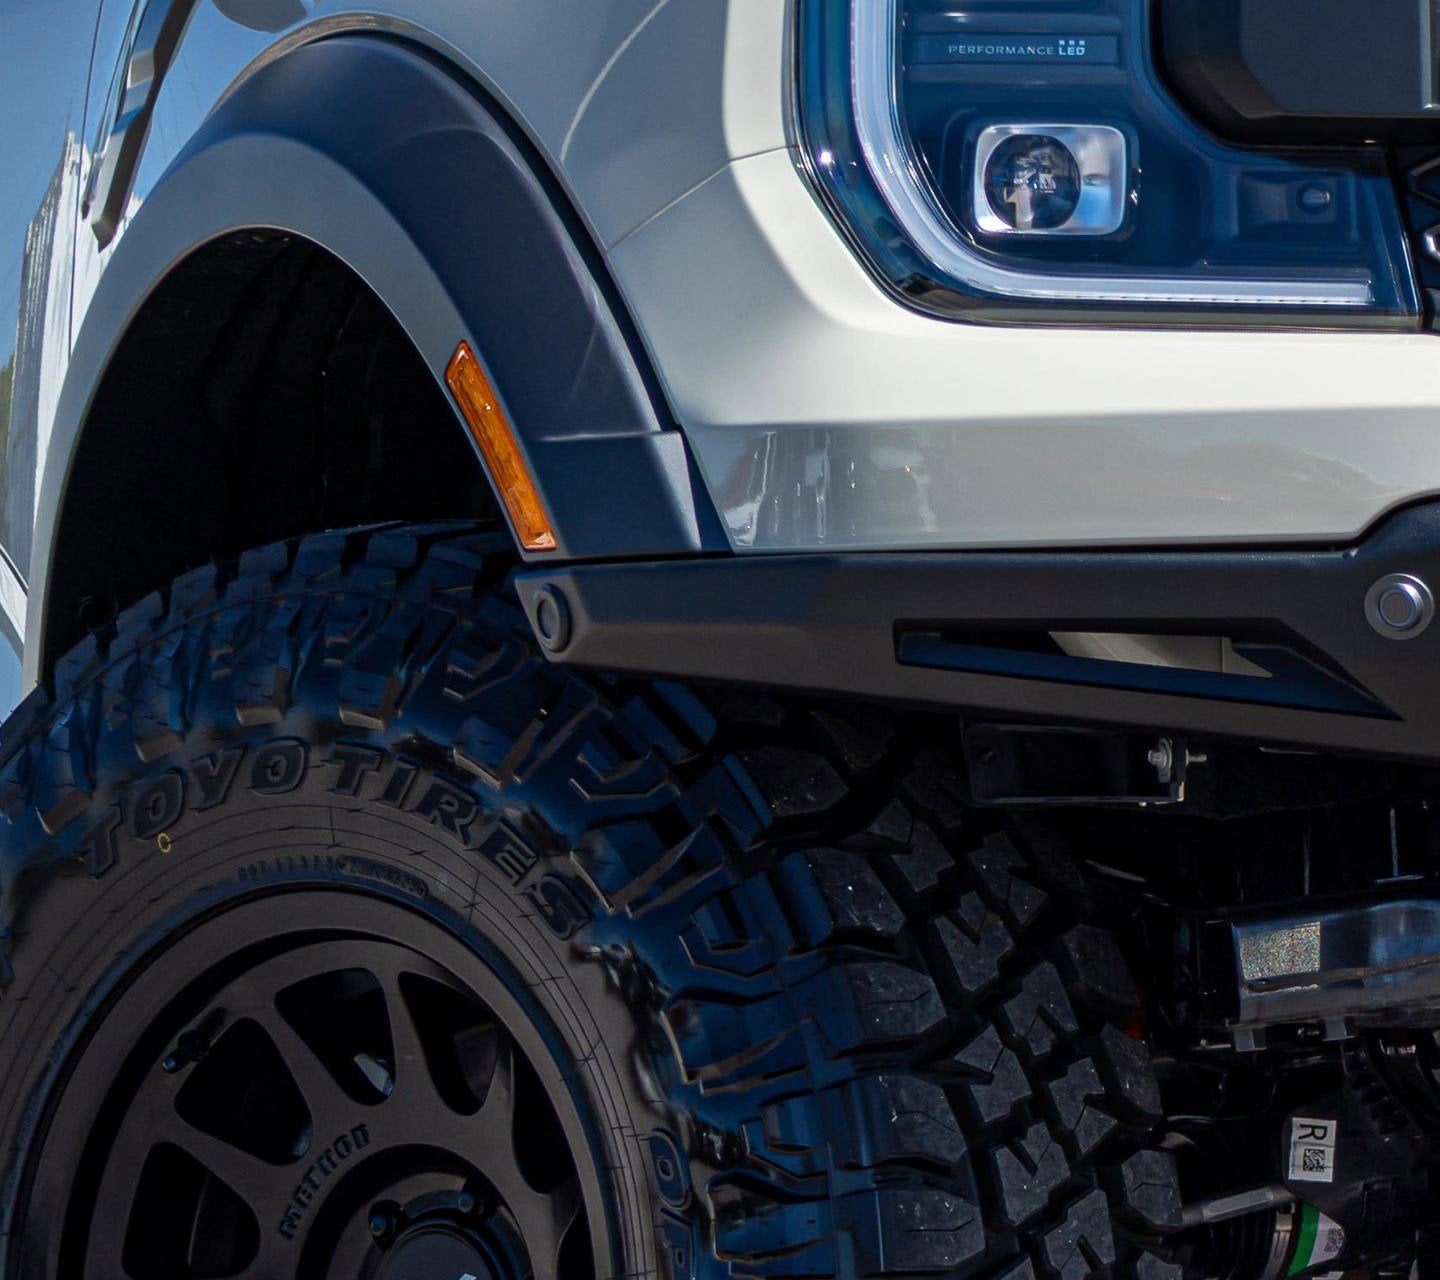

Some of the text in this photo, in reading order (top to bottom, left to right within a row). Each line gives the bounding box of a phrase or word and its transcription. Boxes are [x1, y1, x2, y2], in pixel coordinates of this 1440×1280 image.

[947, 44, 1087, 56] PERFORMANCE LED
[80, 734, 595, 941] TOYO TIRES
[277, 1122, 371, 1241] METHOD
